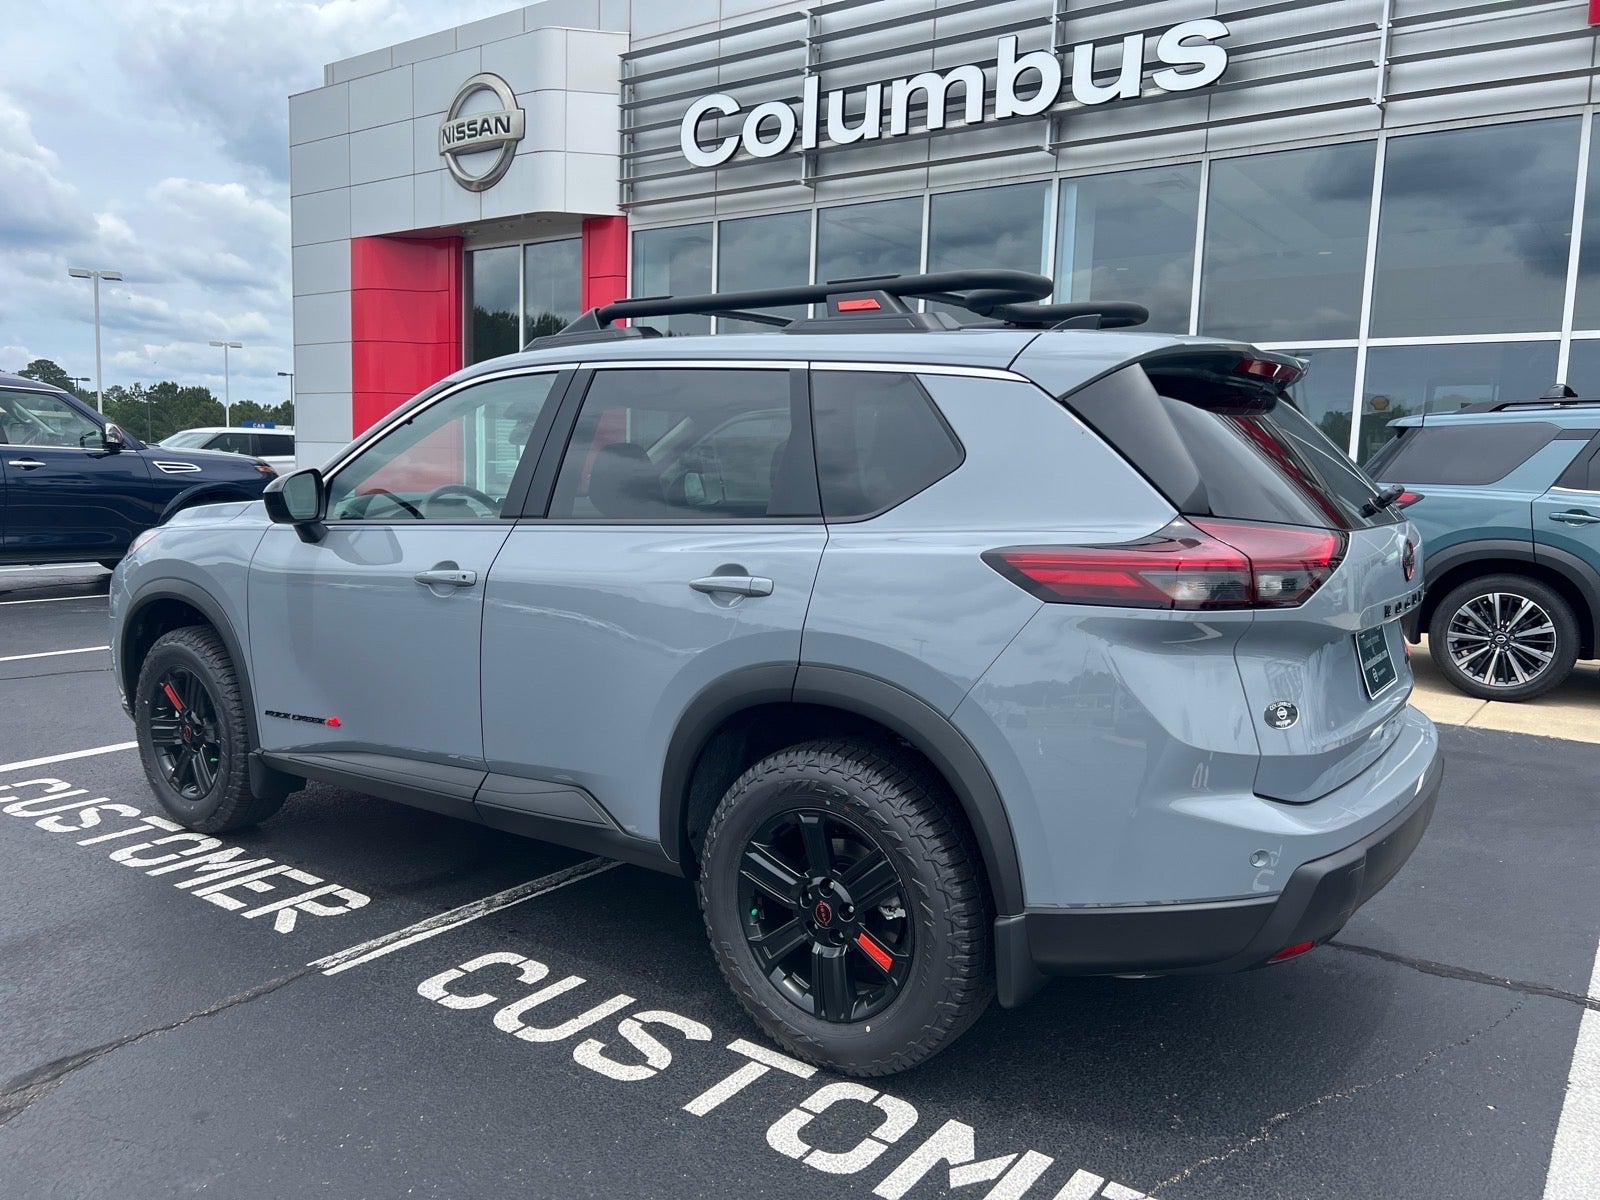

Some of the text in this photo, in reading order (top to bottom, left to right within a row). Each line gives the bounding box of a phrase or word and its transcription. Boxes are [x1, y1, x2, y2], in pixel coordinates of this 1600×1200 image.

[441, 115, 511, 147] NISSAN
[680, 18, 1231, 168] Columbus
[0, 777, 372, 934] CUSTOMER
